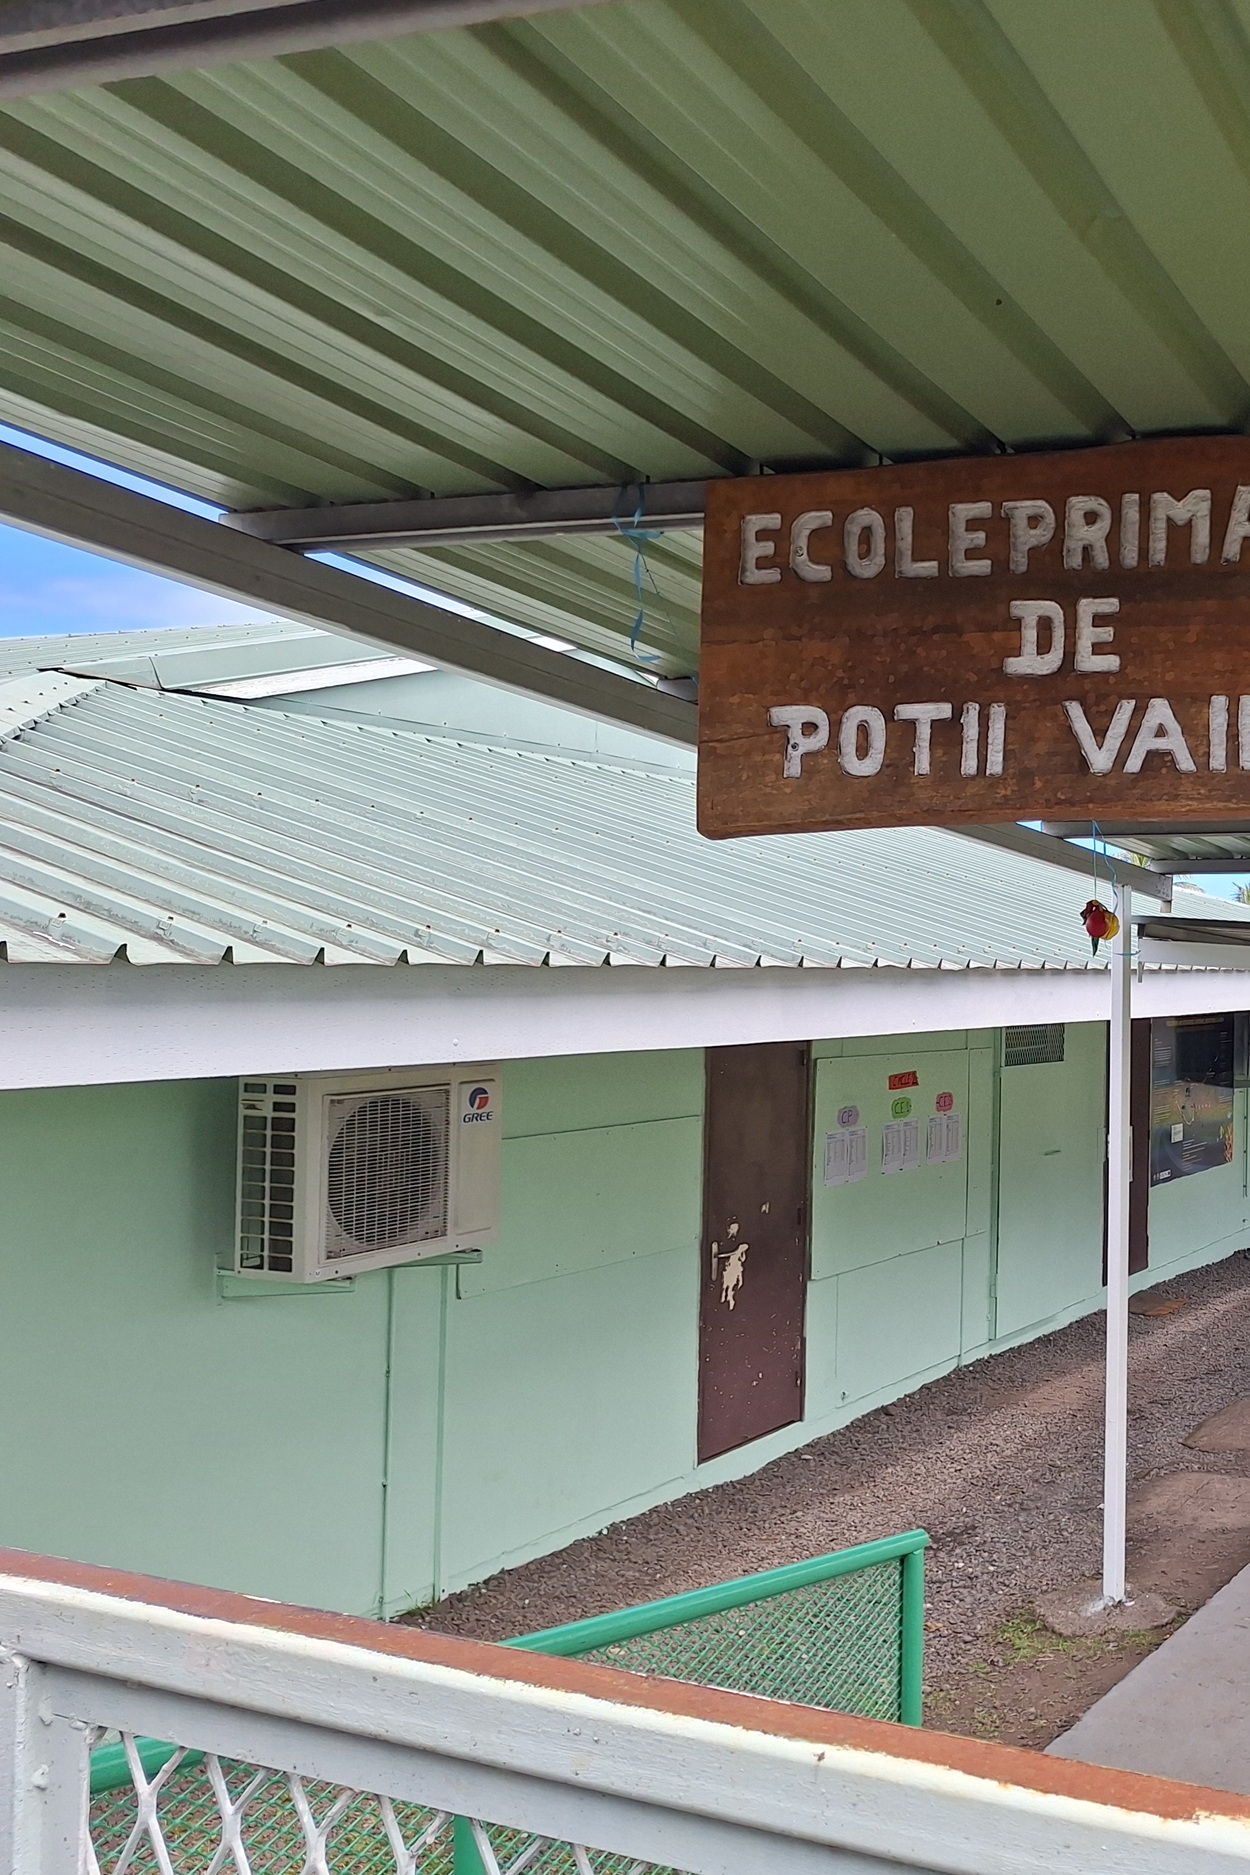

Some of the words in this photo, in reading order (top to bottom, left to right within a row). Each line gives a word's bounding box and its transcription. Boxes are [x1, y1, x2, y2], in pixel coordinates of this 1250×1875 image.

[1003, 597, 1122, 677] DE
[768, 700, 1007, 780] POTII
[463, 1111, 494, 1124] GREE
[841, 1109, 853, 1124] CP
